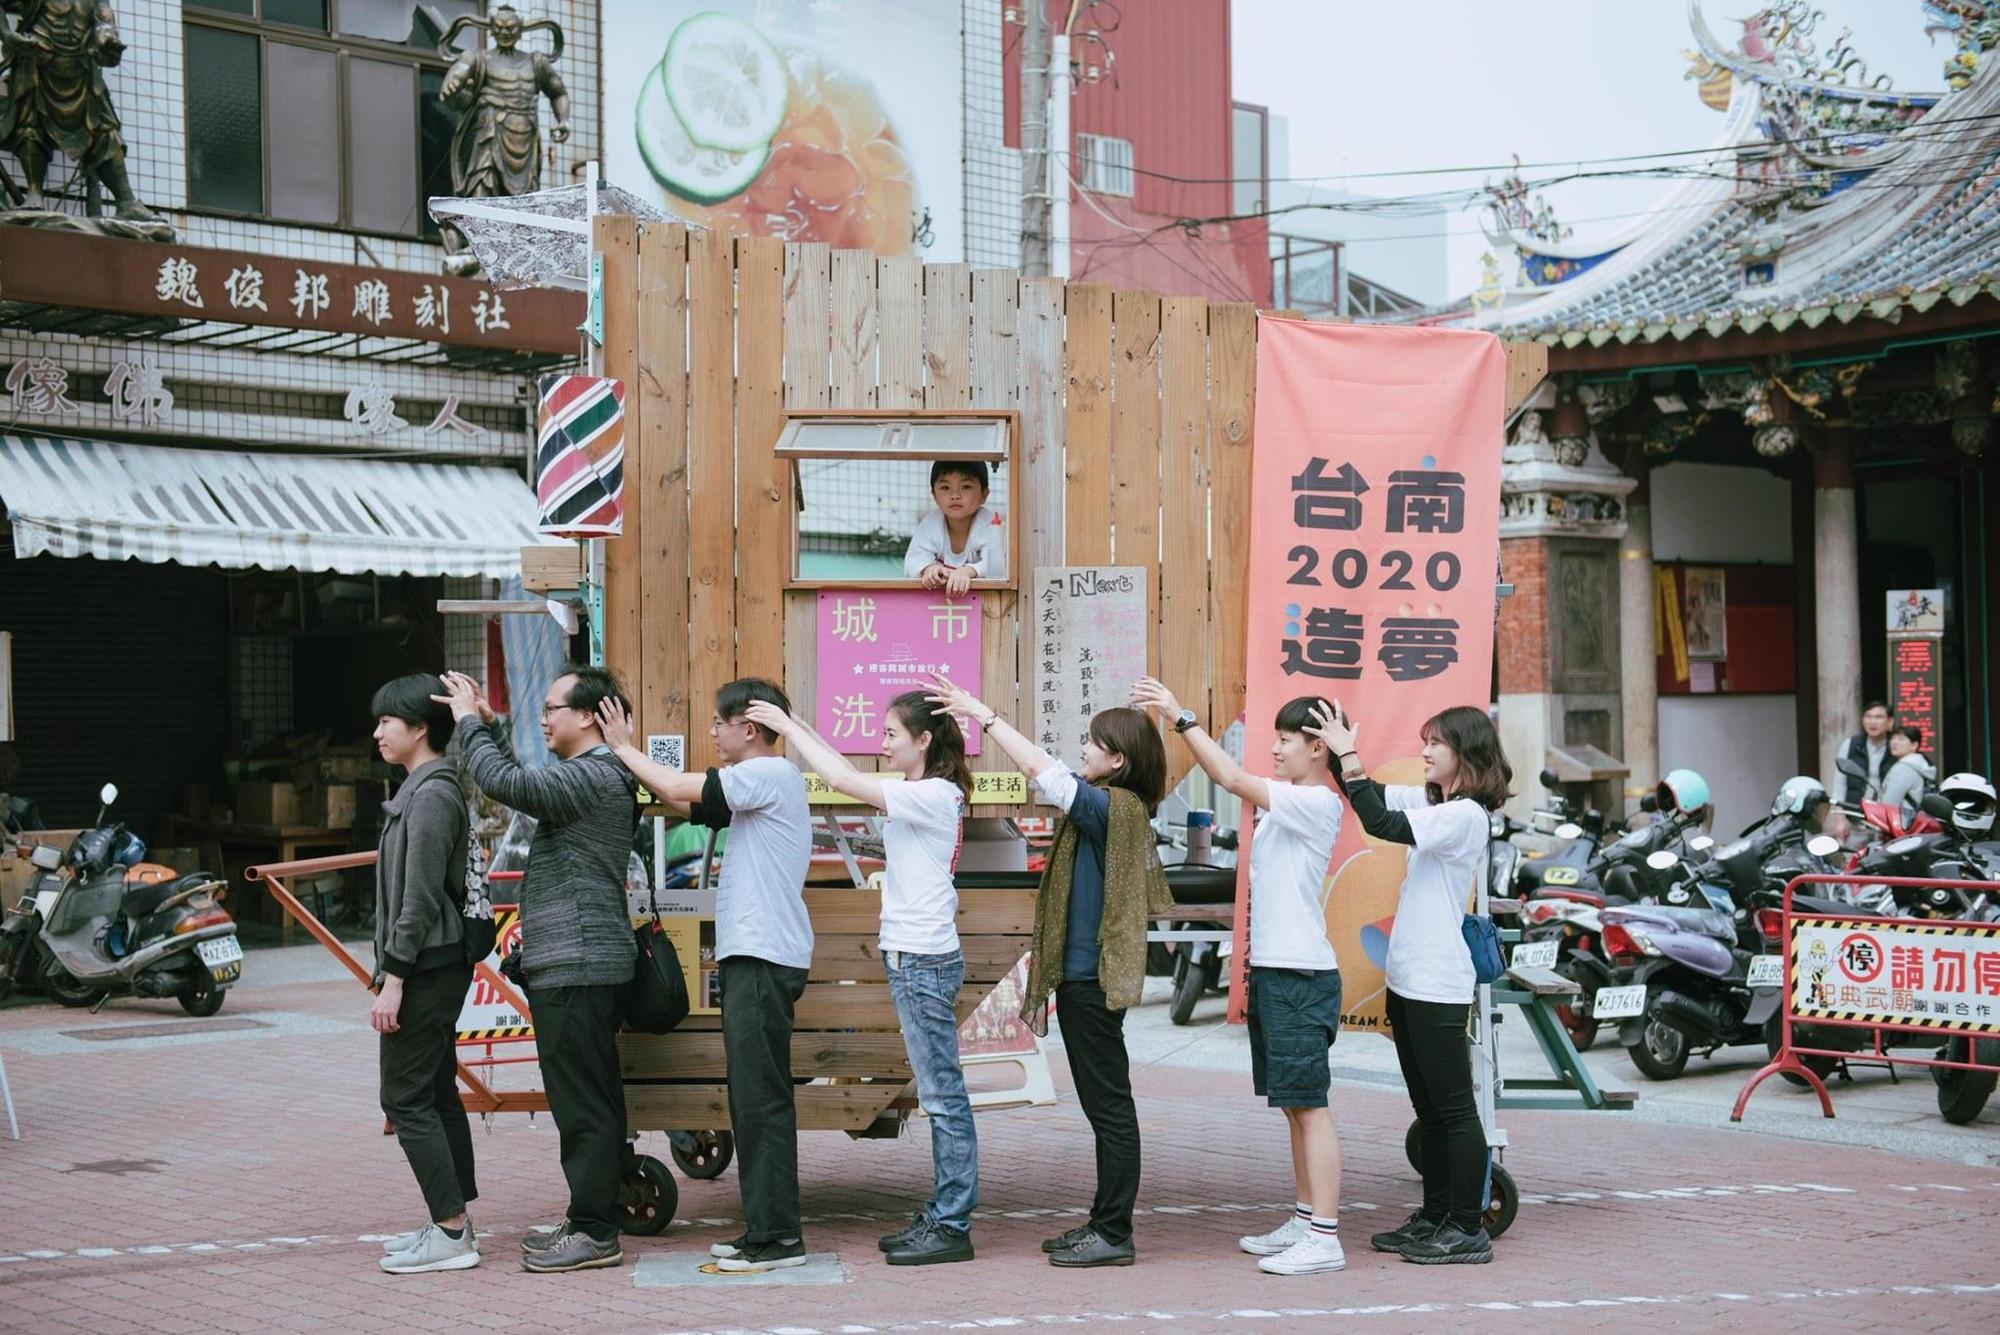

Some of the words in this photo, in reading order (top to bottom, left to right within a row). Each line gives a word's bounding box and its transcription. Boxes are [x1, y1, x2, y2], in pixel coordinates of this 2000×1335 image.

[155, 256, 511, 335] 魏俊邦雕刻社
[1291, 455, 1466, 534] 台南
[1286, 545, 1462, 591] 2020
[1280, 602, 1460, 682] 造夢
[1846, 943, 1875, 971] 停
[1340, 1015, 1378, 1026] REAM
